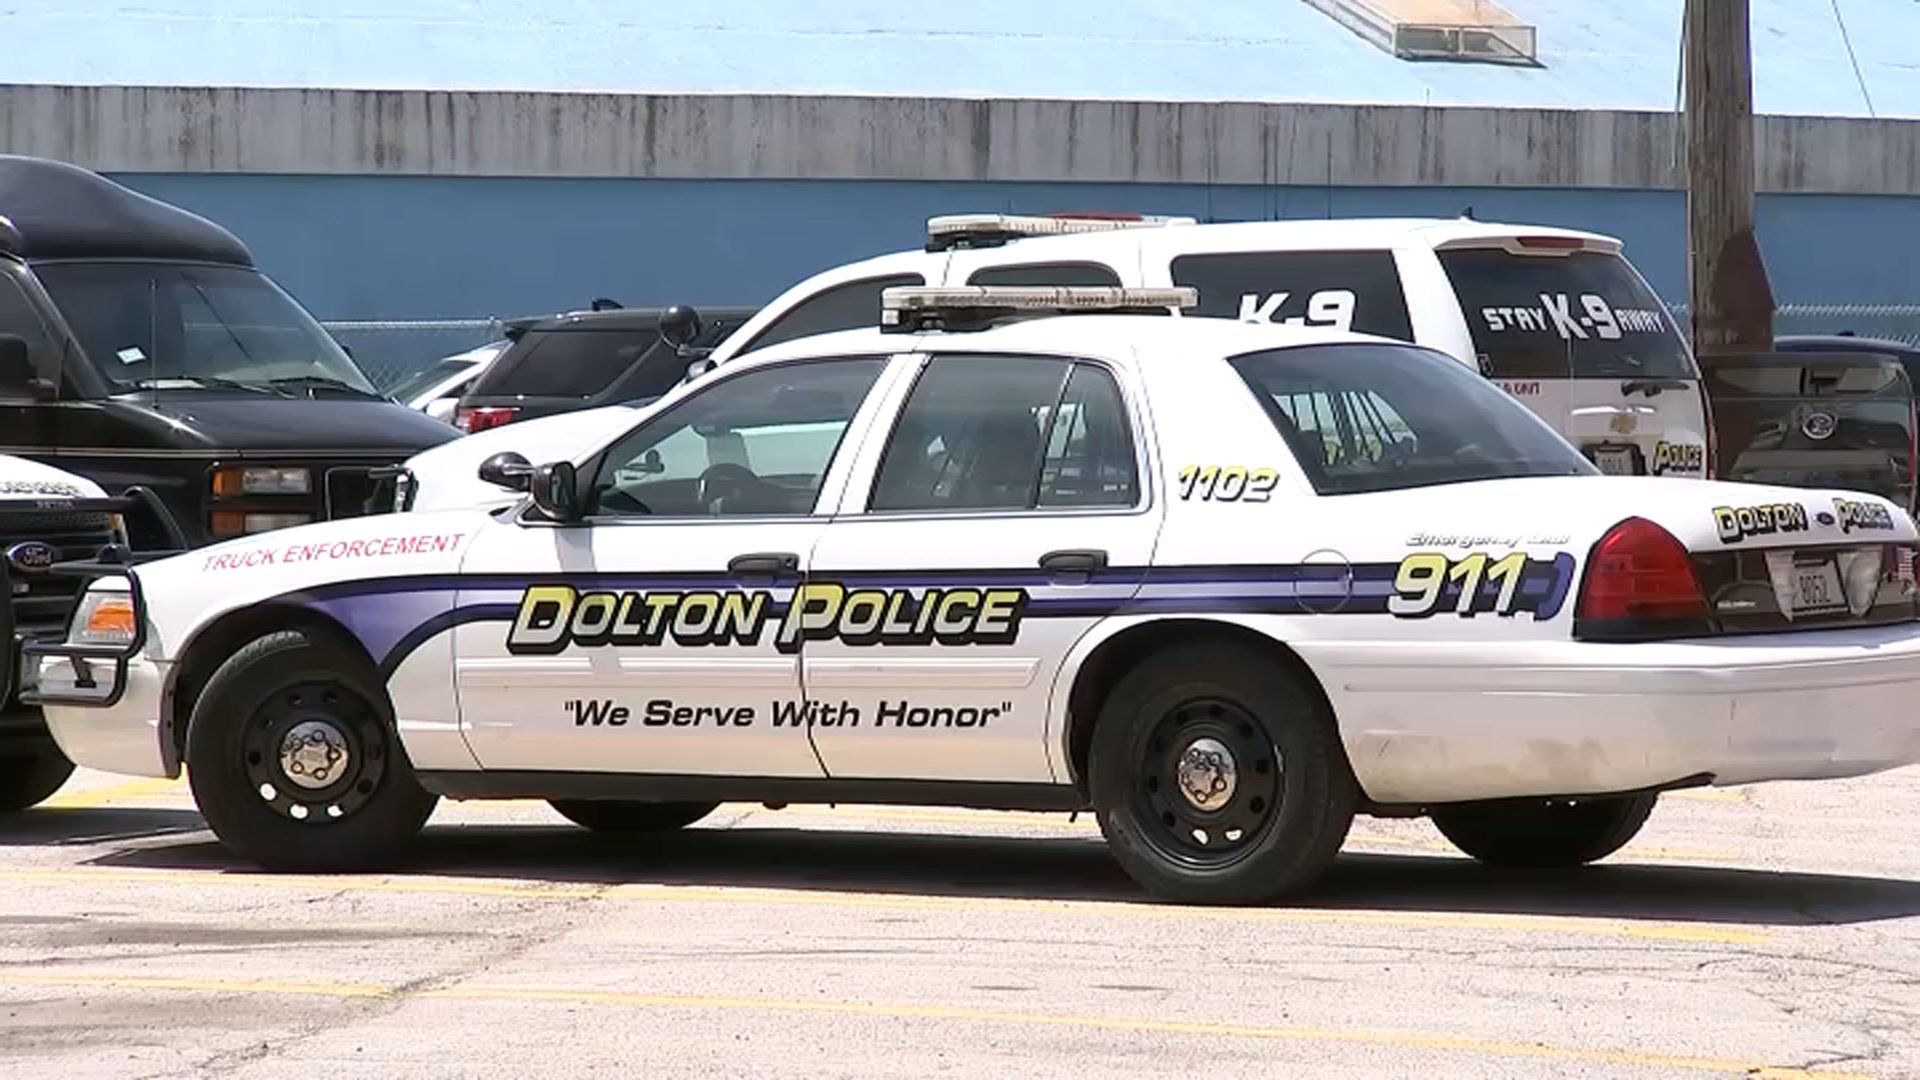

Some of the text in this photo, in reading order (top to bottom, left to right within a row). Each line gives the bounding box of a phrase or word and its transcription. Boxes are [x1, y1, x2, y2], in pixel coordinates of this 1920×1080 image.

[1240, 290, 1357, 333] K-9
[1482, 308, 1547, 332] STAY
[1540, 293, 1622, 339] K-9
[1178, 464, 1280, 502] 1102
[1712, 503, 1809, 544] DOLTON
[202, 533, 465, 572] TRUCK ENFORCEMENT
[1387, 551, 1530, 619] 911
[507, 582, 1028, 655] DOLTON POLICE
[563, 700, 1012, 728] "We Serve With Honor"
